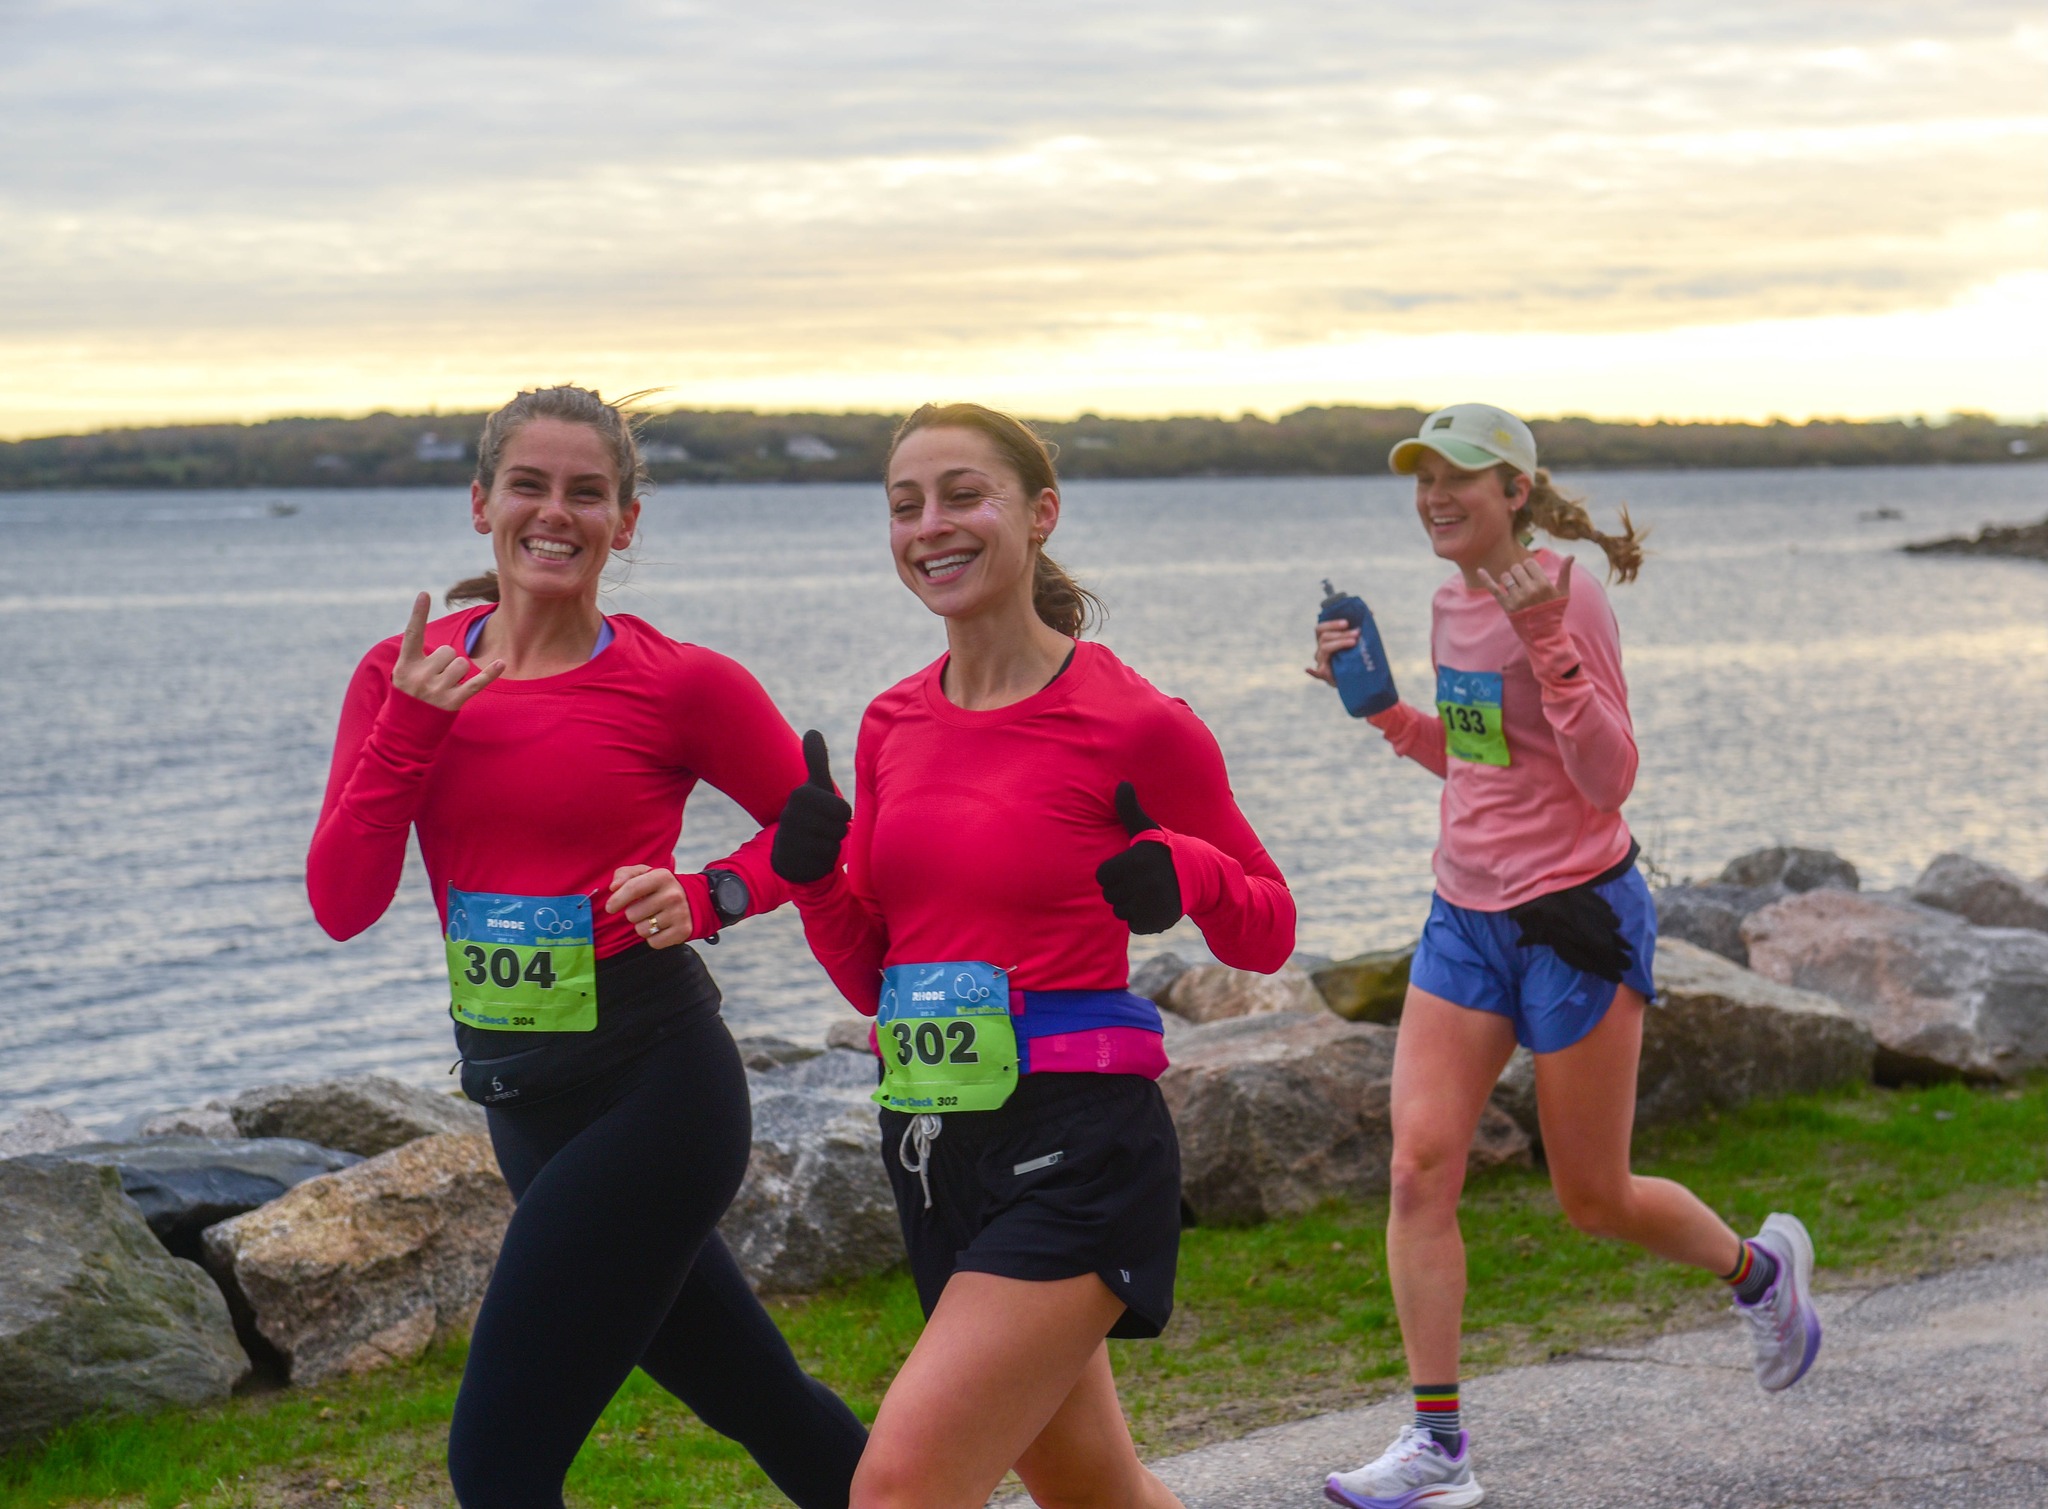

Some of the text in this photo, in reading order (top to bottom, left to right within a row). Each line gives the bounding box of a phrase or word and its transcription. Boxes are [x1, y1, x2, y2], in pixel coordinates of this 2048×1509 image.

[1446, 705, 1486, 735] 133
[487, 919, 525, 930] RHODE
[464, 945, 556, 989] 304
[912, 990, 945, 1002] RHODE
[512, 1016, 535, 1026] 304
[892, 1021, 979, 1066] 302
[937, 1096, 959, 1107] 302
